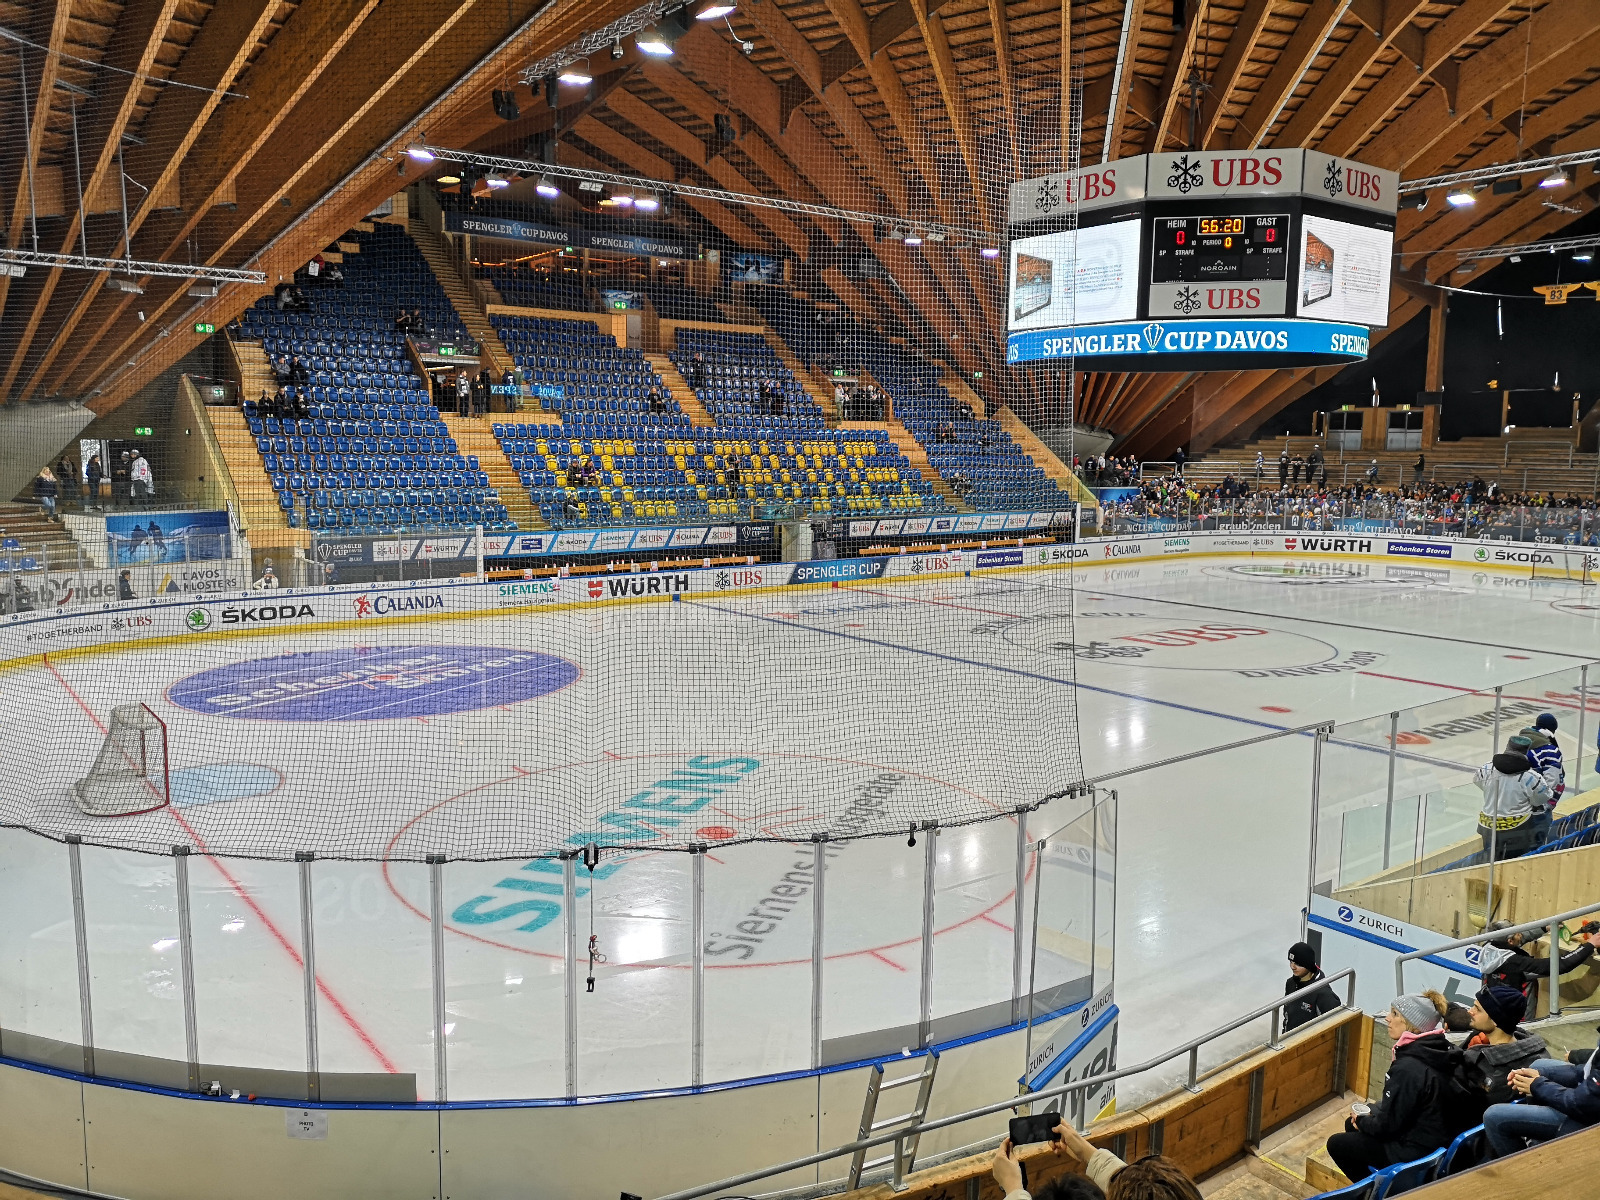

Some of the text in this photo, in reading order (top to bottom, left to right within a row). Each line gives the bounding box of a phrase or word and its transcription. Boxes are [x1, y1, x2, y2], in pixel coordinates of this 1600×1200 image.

[1210, 157, 1283, 187] UBS
[1064, 169, 1117, 204] UBS
[1346, 168, 1381, 202] UBS
[463, 220, 569, 241] SPENGLER CUP DAVOS
[1167, 217, 1277, 233] HEIM 56:20 GAST
[591, 236, 684, 255] SPENGLER CUP DAVOS
[1176, 228, 1275, 245] 0 0
[1205, 288, 1261, 310] UBS
[1550, 290, 1563, 299] 83
[1043, 330, 1288, 356] SPENGLER CUP DAVOS
[483, 541, 501, 549] UBS
[1112, 544, 1141, 557] CALANDA
[1163, 538, 1190, 547] SIEMENS
[1301, 538, 1372, 553] WÜRTH
[1389, 545, 1450, 555] Schenker Storen
[1052, 548, 1089, 559] ŠKODA
[1495, 550, 1554, 565] ŠKODA
[797, 562, 881, 580] SPENGLER CUP
[925, 556, 949, 571] UBS
[607, 574, 689, 597] WÜRTH
[732, 570, 763, 587] UBS
[499, 582, 555, 597] SIEMENS
[373, 594, 444, 615] CALANDA
[127, 615, 153, 628] UBS
[221, 604, 316, 624] ŠKODA
[26, 624, 103, 642] #TOGETHERBAND
[1111, 623, 1268, 647] UBS
[1233, 663, 1357, 678] DAVOS
[451, 754, 761, 934] SIEMENS
[703, 860, 826, 961] Siemens
[1358, 914, 1404, 937] ZURICH
[1028, 1042, 1054, 1074] ZURICH
[1091, 989, 1113, 1016] ZURICH
